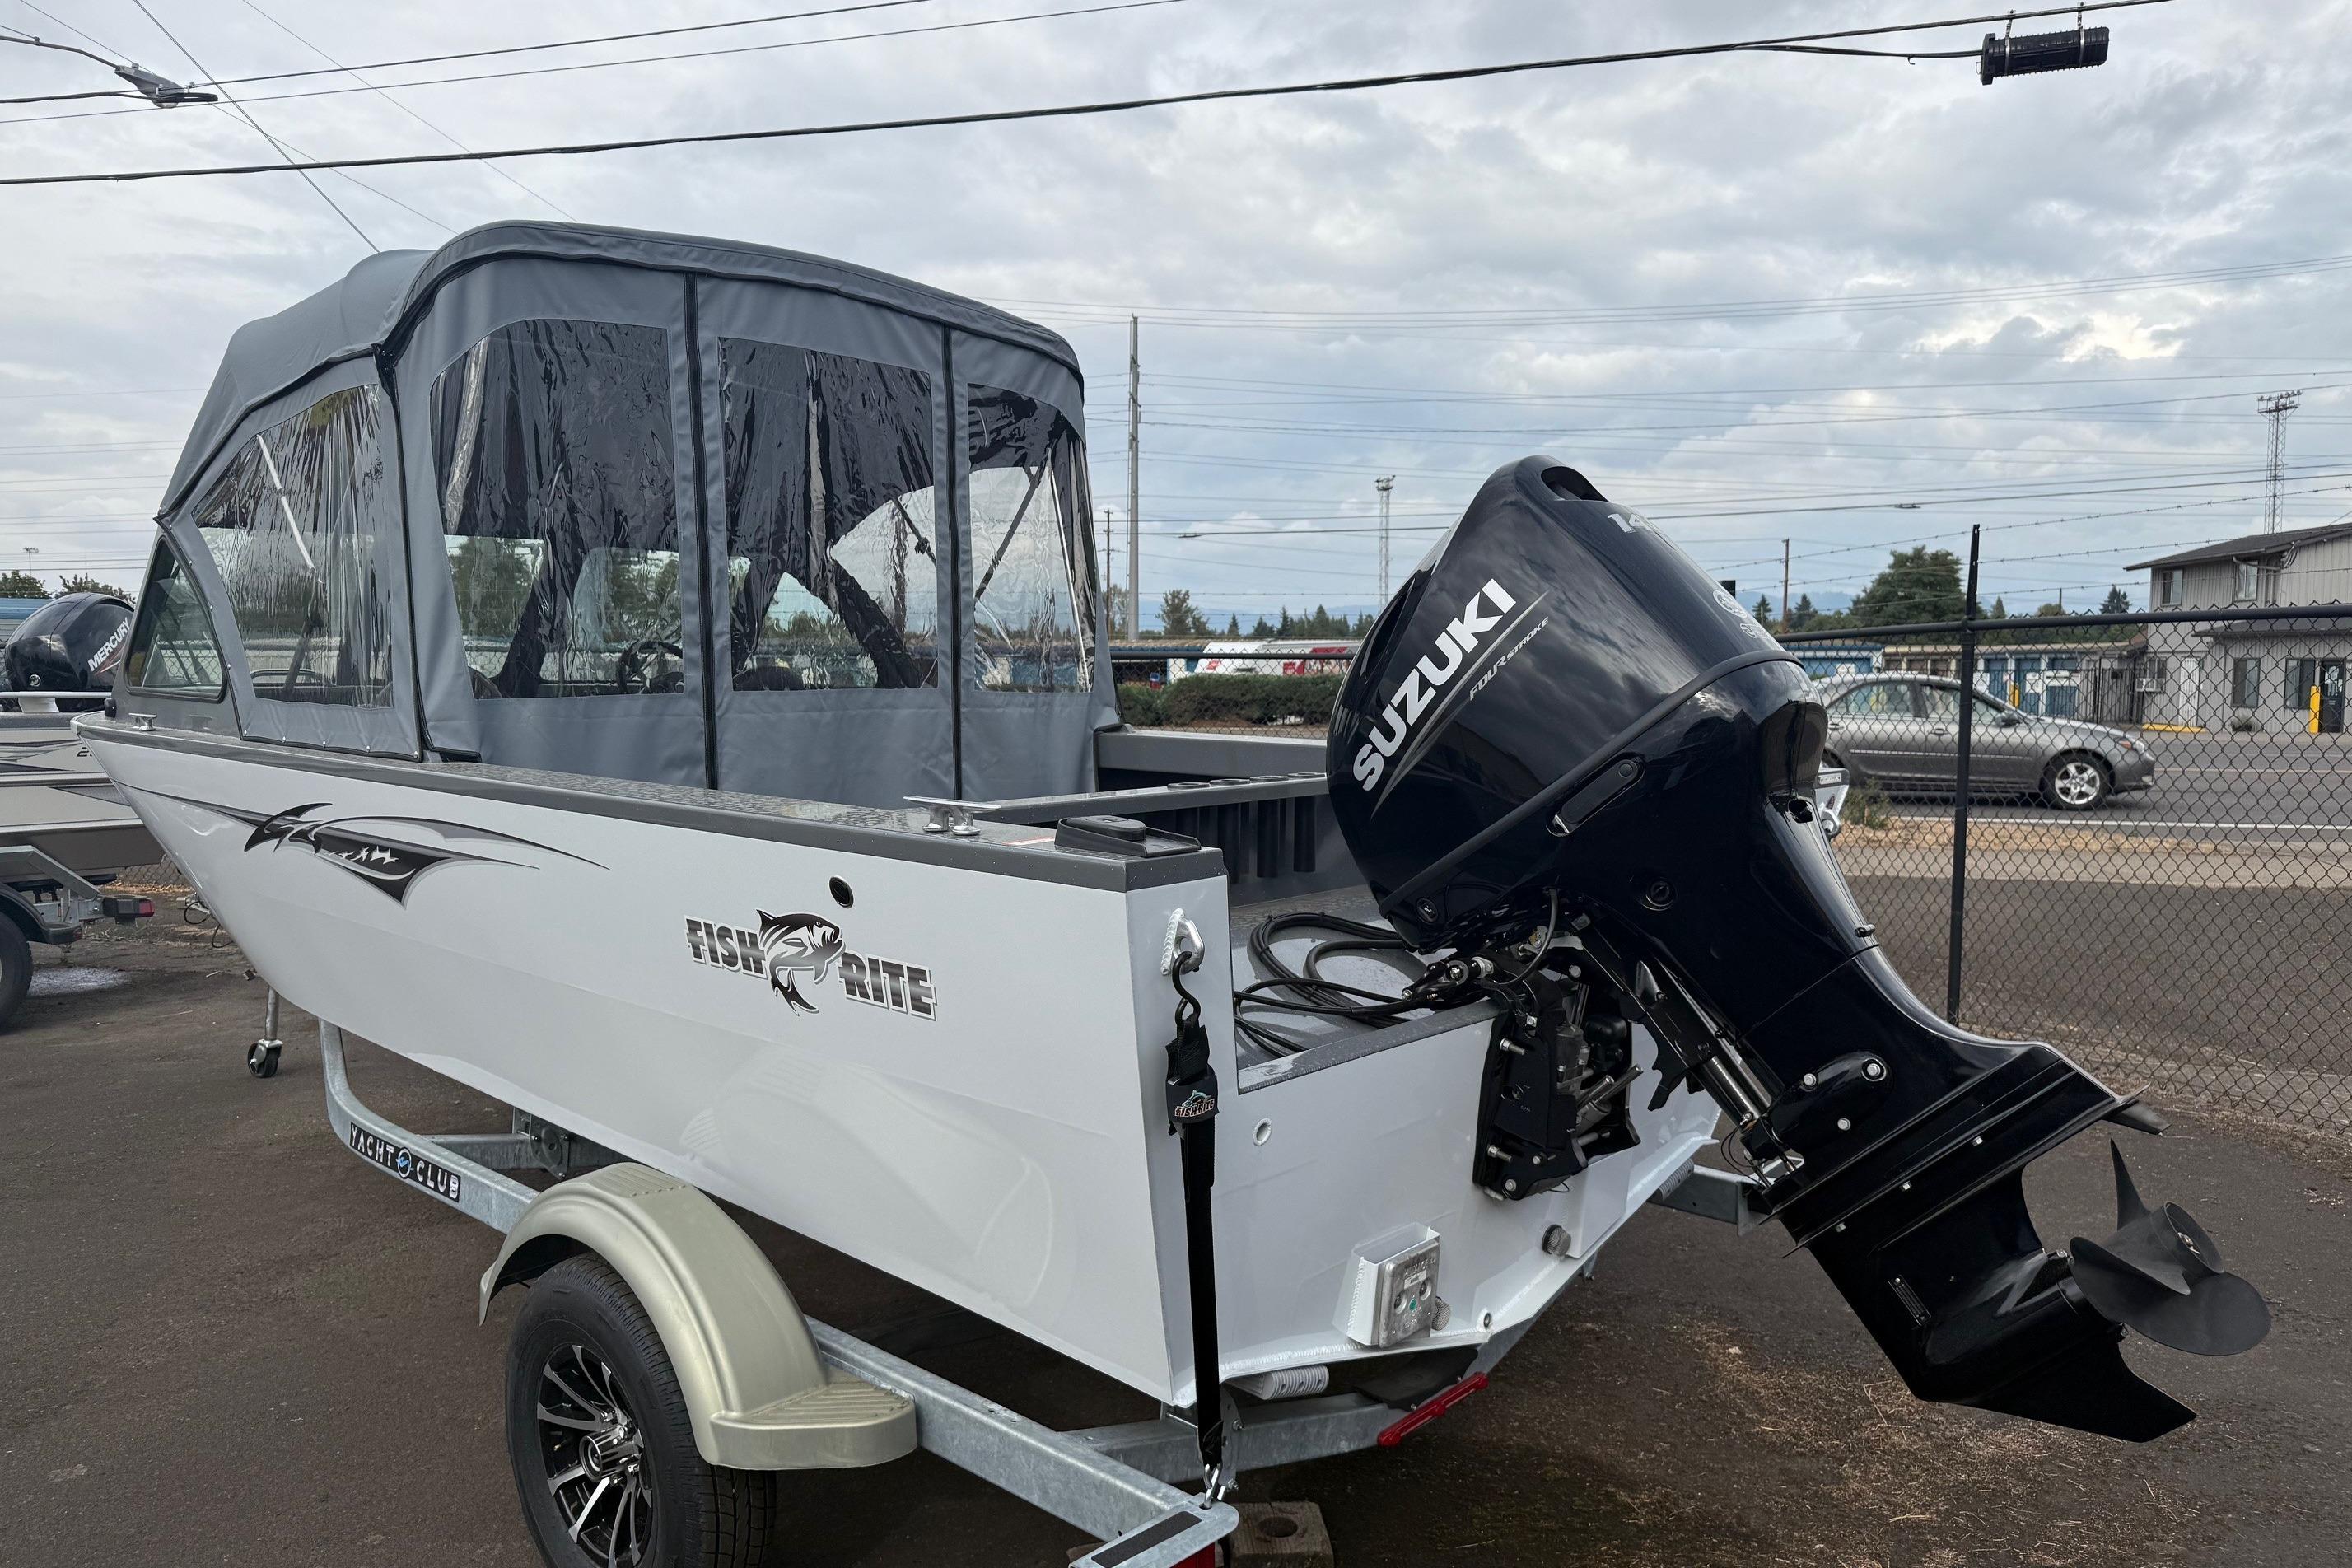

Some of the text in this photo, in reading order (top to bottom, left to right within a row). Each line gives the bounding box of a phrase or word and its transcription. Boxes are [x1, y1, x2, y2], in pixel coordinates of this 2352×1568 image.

[87, 617, 130, 671] MERCURY
[1353, 578, 1516, 791] SUZUKI
[76, 746, 93, 757] 2
[684, 915, 937, 1021] FISH RITE
[352, 1124, 459, 1200] YACHT CLUB
